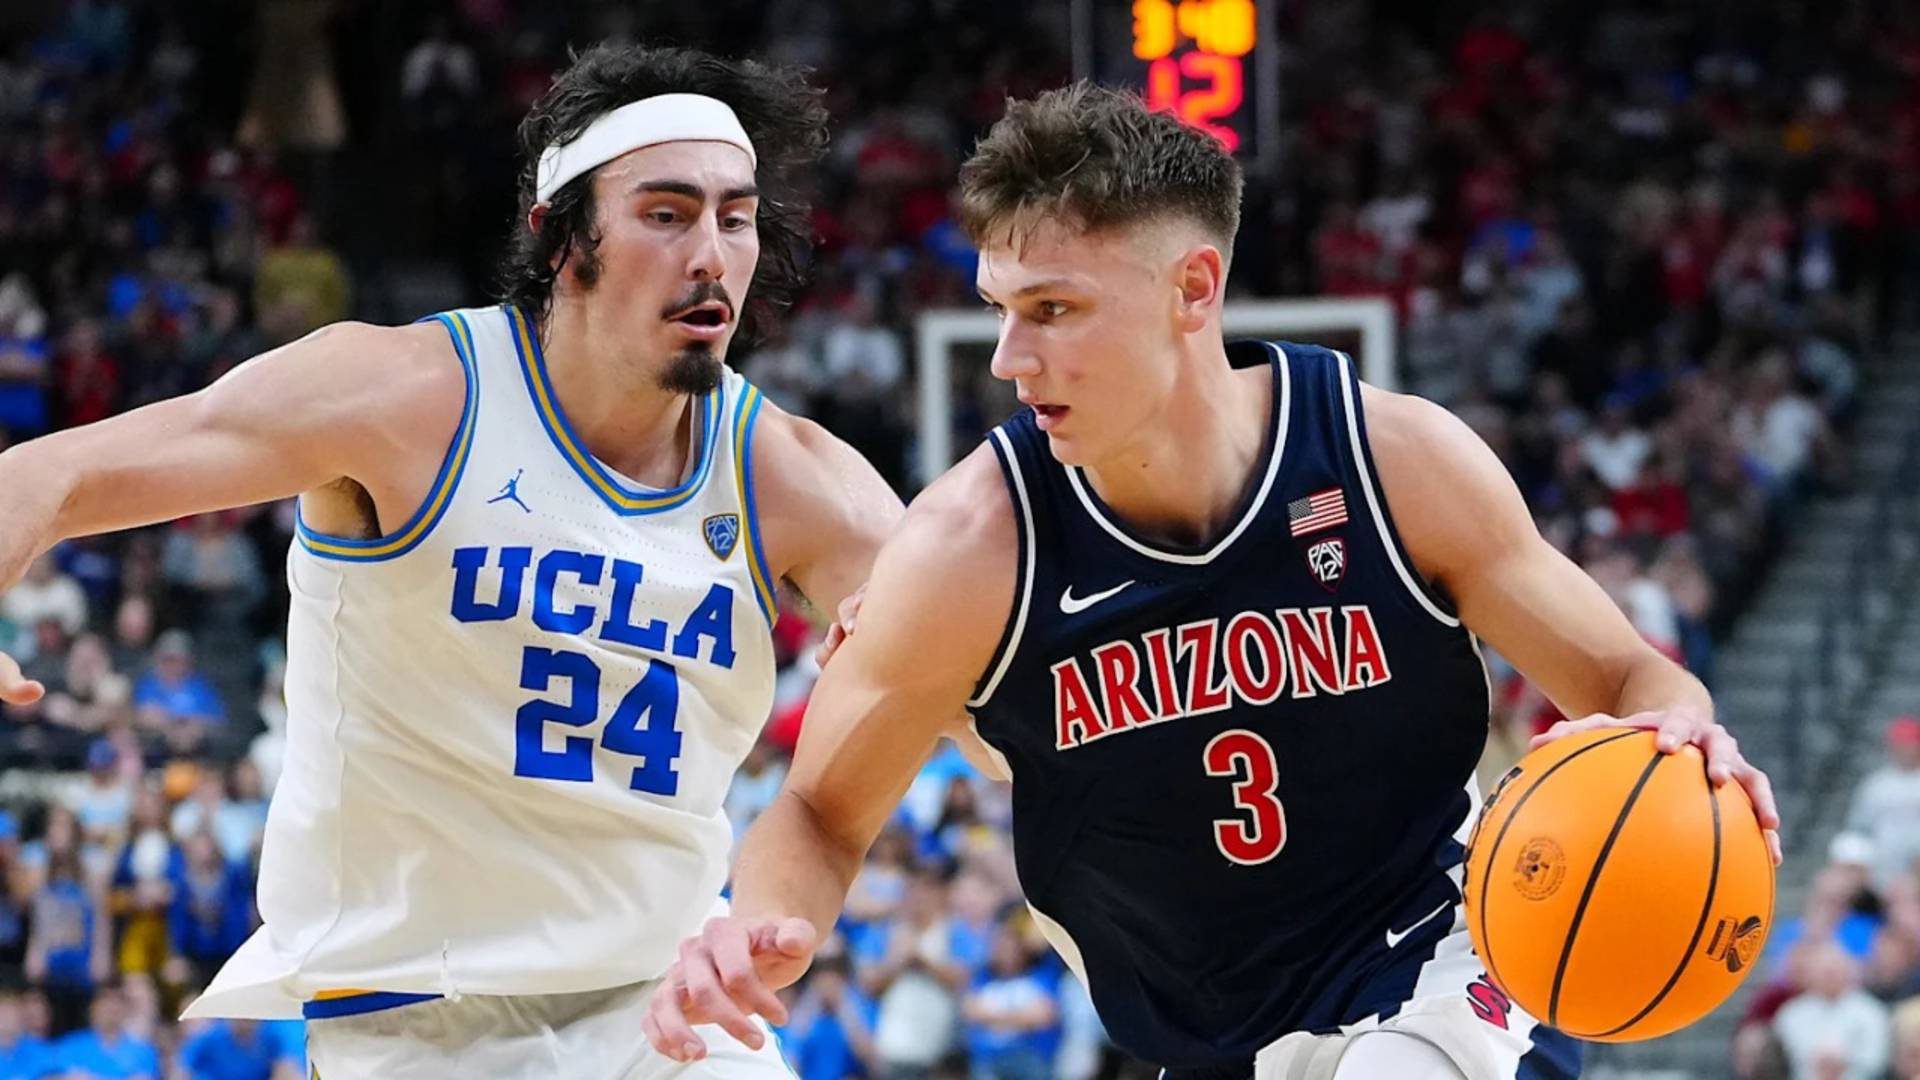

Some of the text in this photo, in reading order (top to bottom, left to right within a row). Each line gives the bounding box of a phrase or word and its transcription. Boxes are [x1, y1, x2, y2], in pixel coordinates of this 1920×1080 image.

[705, 515, 737, 543] PAC
[713, 532, 732, 551] 12
[1308, 540, 1344, 574] PAC
[450, 546, 737, 670] UCLA
[1319, 560, 1339, 582] 12
[1050, 604, 1392, 752] ARIZONA
[514, 645, 683, 797] 24
[1203, 728, 1288, 866] 3
